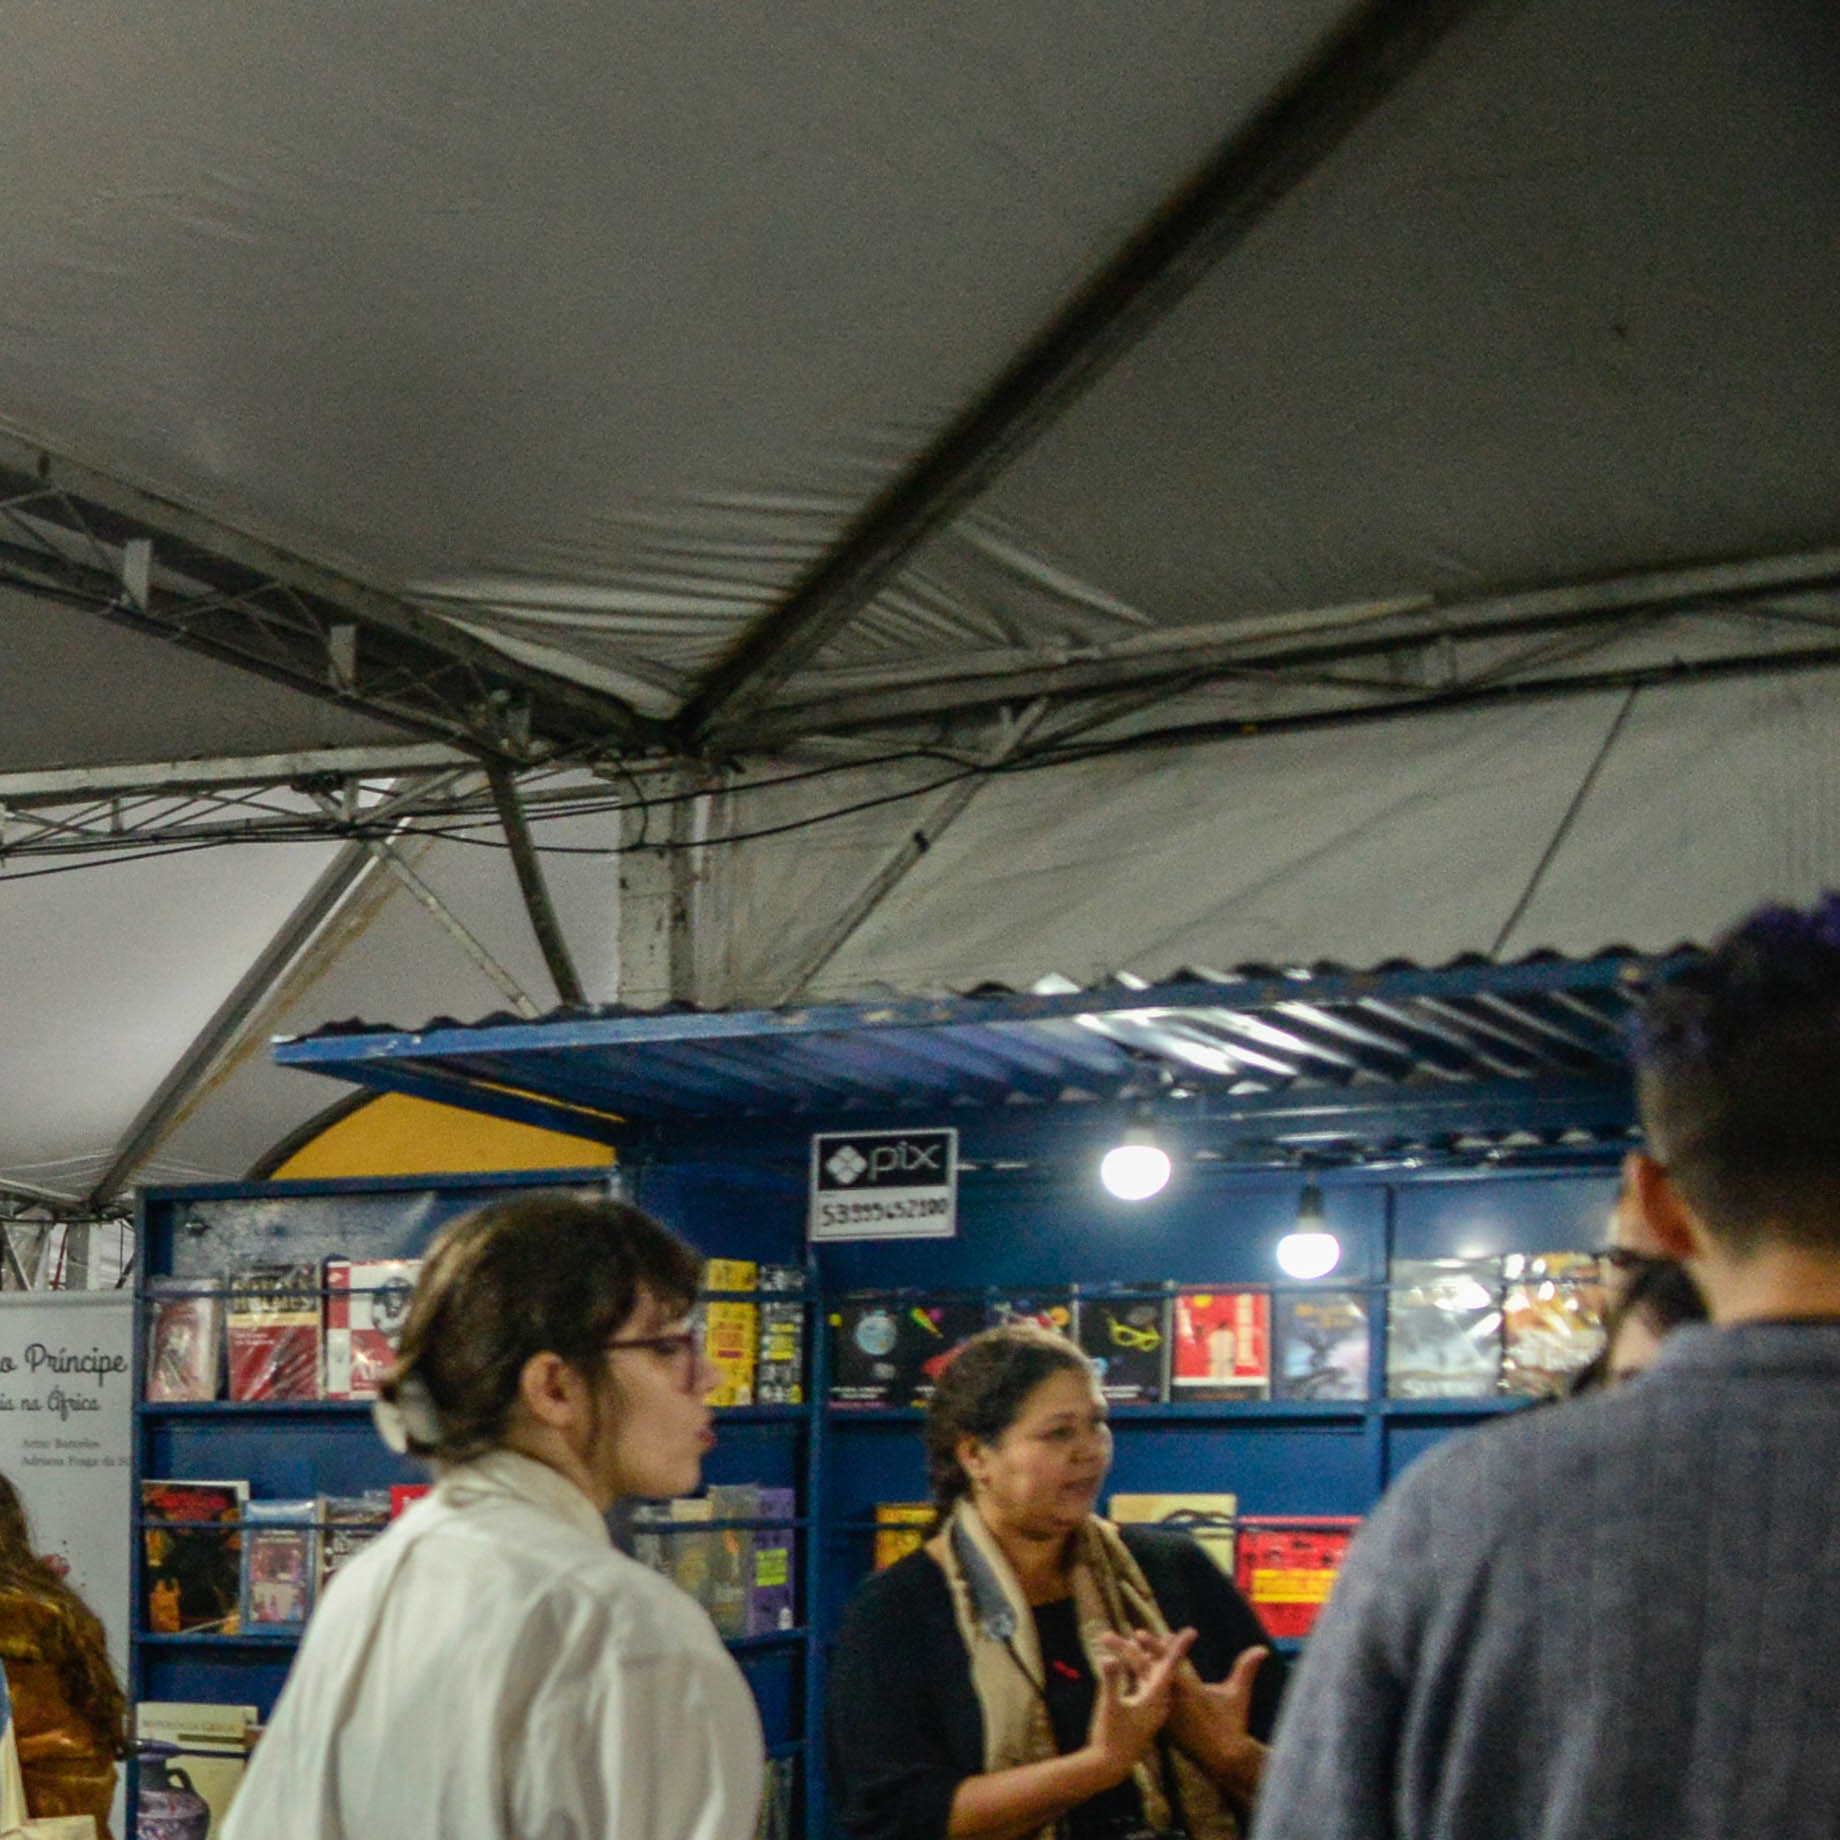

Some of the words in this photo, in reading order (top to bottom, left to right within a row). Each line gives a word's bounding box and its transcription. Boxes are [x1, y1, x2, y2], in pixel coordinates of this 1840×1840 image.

[872, 1140, 941, 1181] pix
[24, 1343, 129, 1388] Príncipe
[21, 1398, 42, 1411] na
